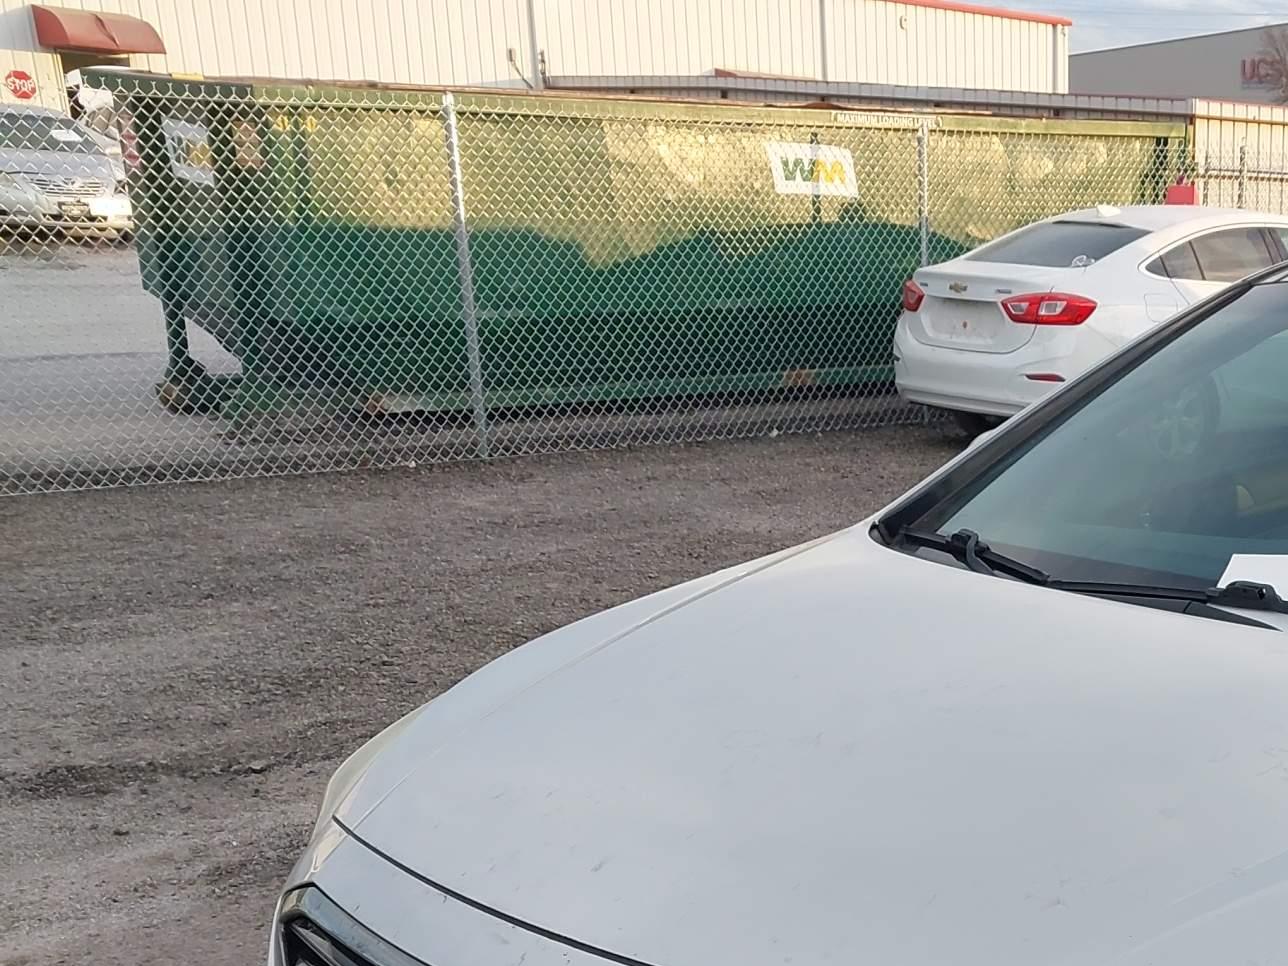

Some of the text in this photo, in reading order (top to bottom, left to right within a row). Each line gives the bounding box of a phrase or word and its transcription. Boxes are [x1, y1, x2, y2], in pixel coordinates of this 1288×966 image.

[7, 77, 35, 91] STOP
[837, 112, 880, 124] MAXIMUM
[880, 115, 914, 126] LOADING
[781, 157, 846, 184] WM
